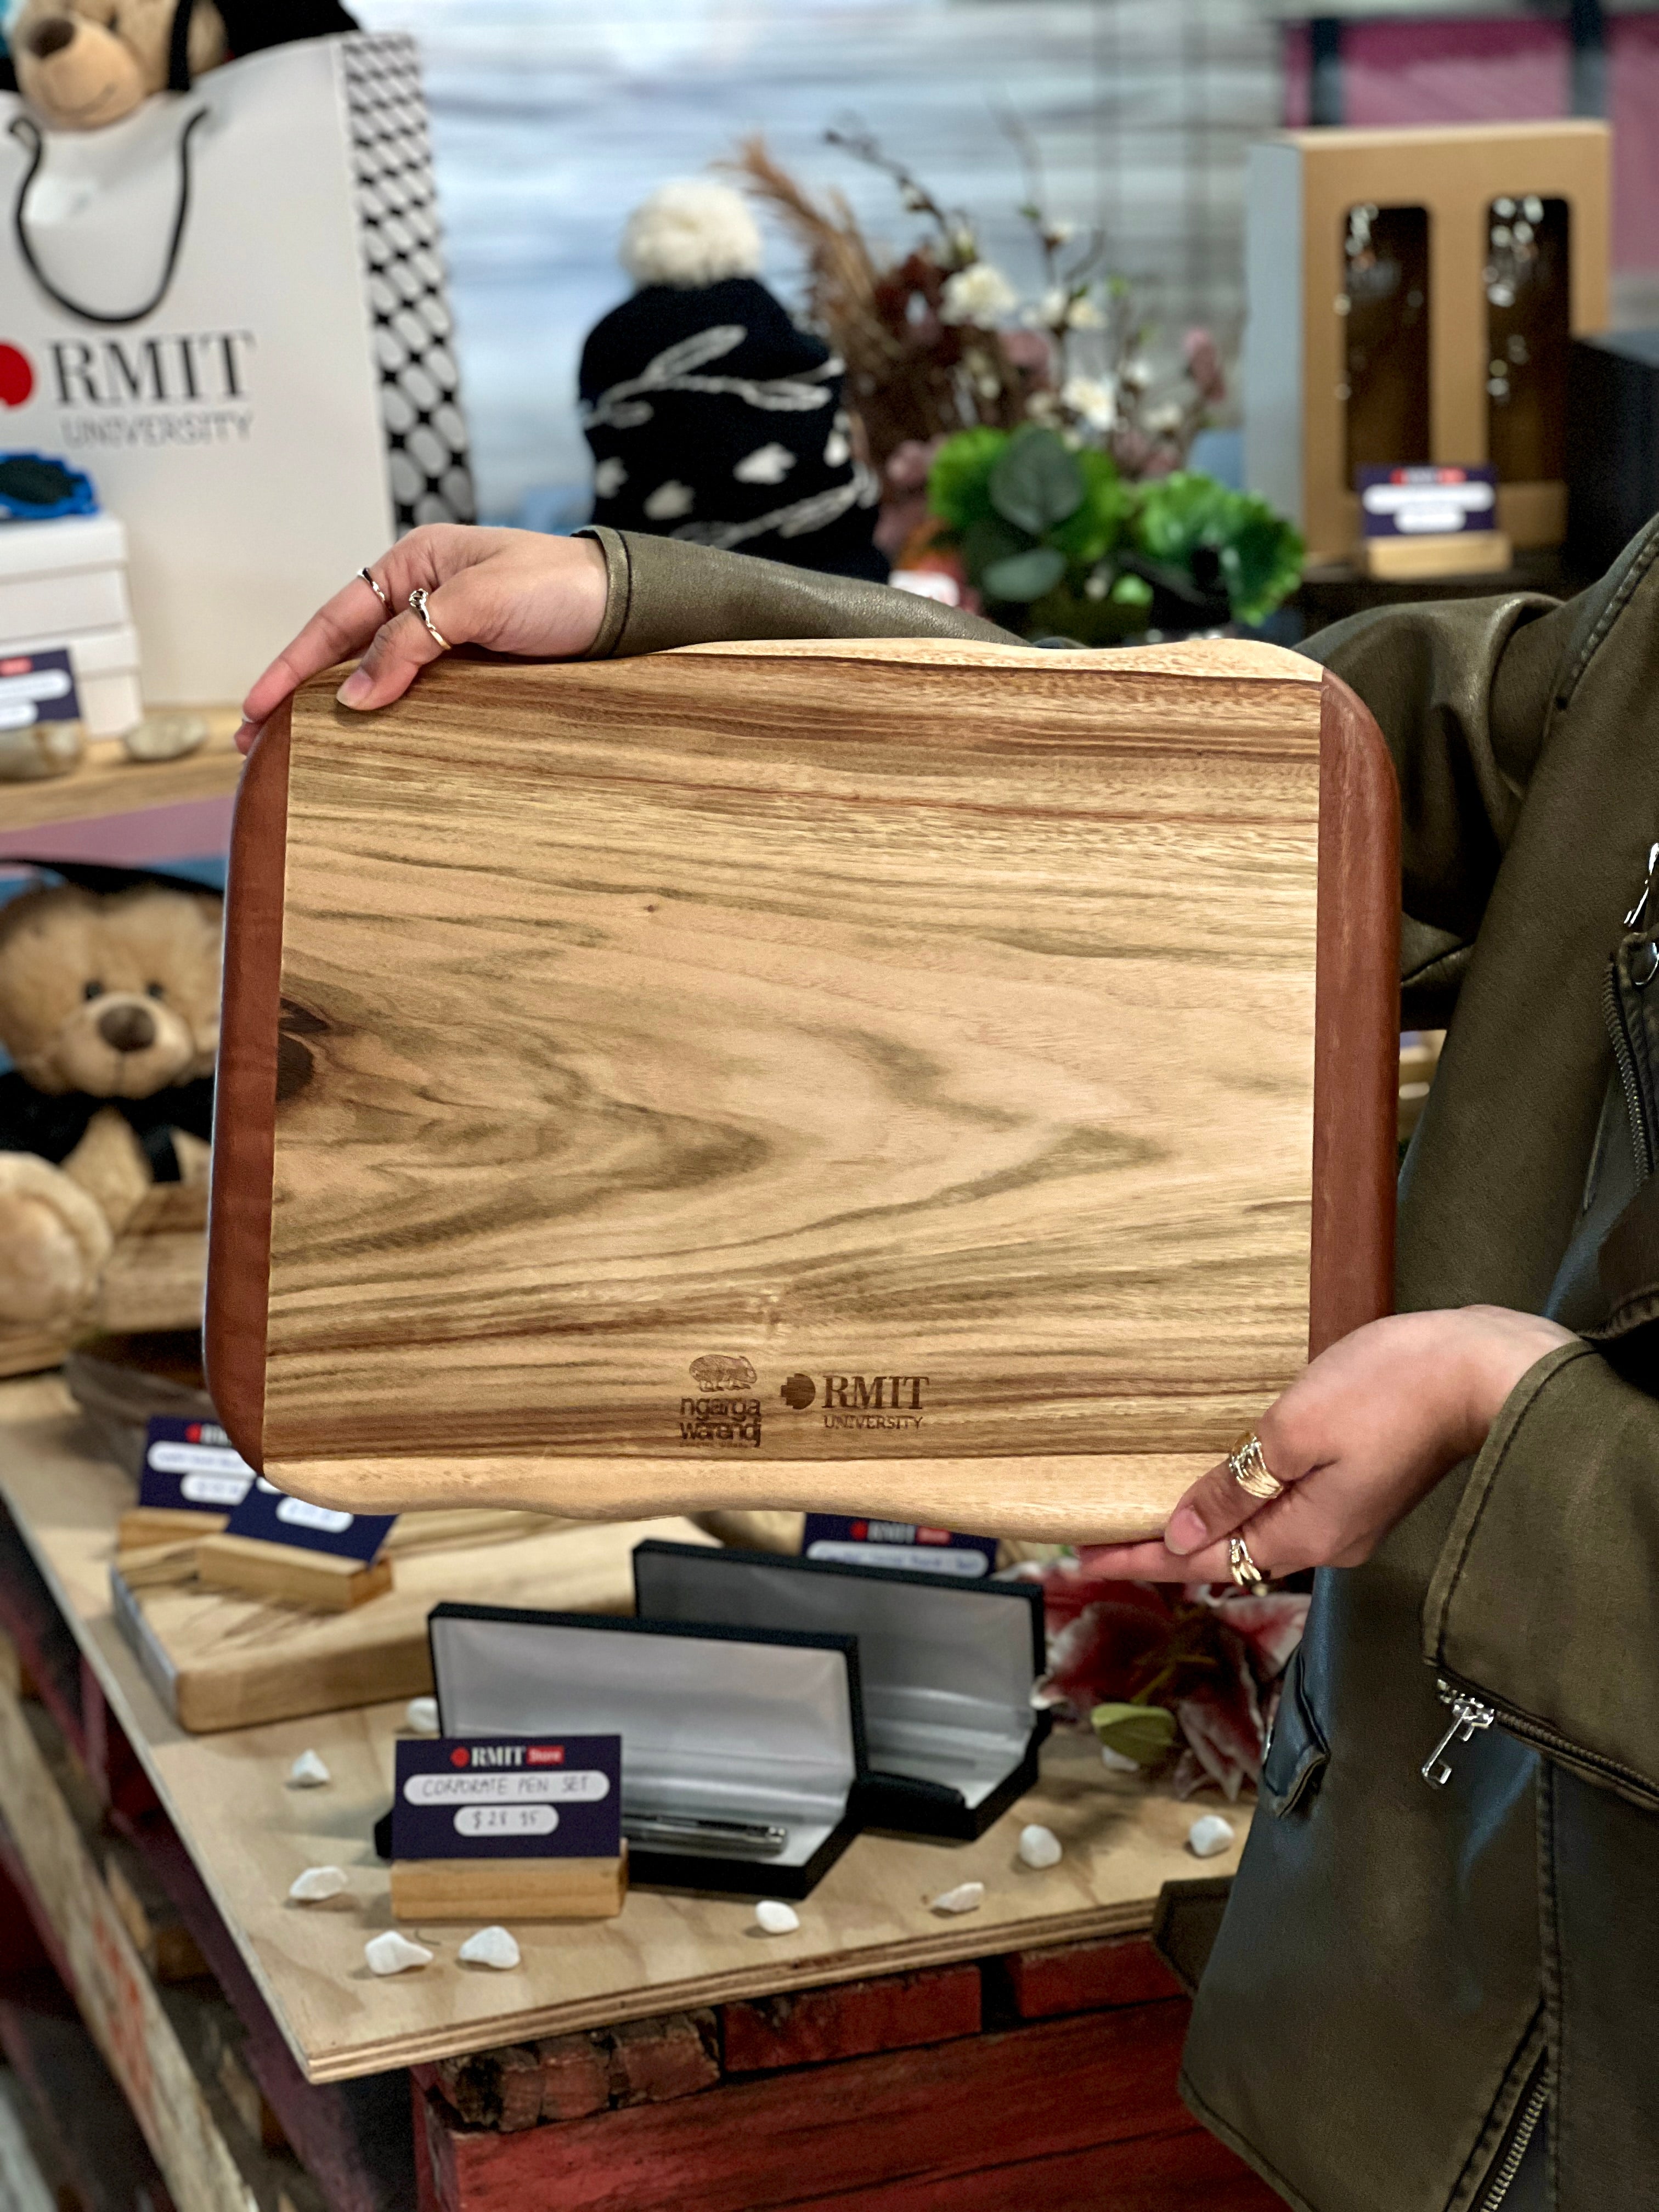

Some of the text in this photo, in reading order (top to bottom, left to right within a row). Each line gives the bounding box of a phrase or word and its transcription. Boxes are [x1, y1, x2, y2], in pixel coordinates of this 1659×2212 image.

[48, 330, 255, 406] RMIT
[59, 410, 253, 448] UNIVERSITY
[821, 1375, 929, 1409] RMIT
[824, 1414, 923, 1429] UNIVERSITY
[472, 1746, 526, 1767] RMIT
[422, 1775, 589, 1797] CORPORATE PEN SET
